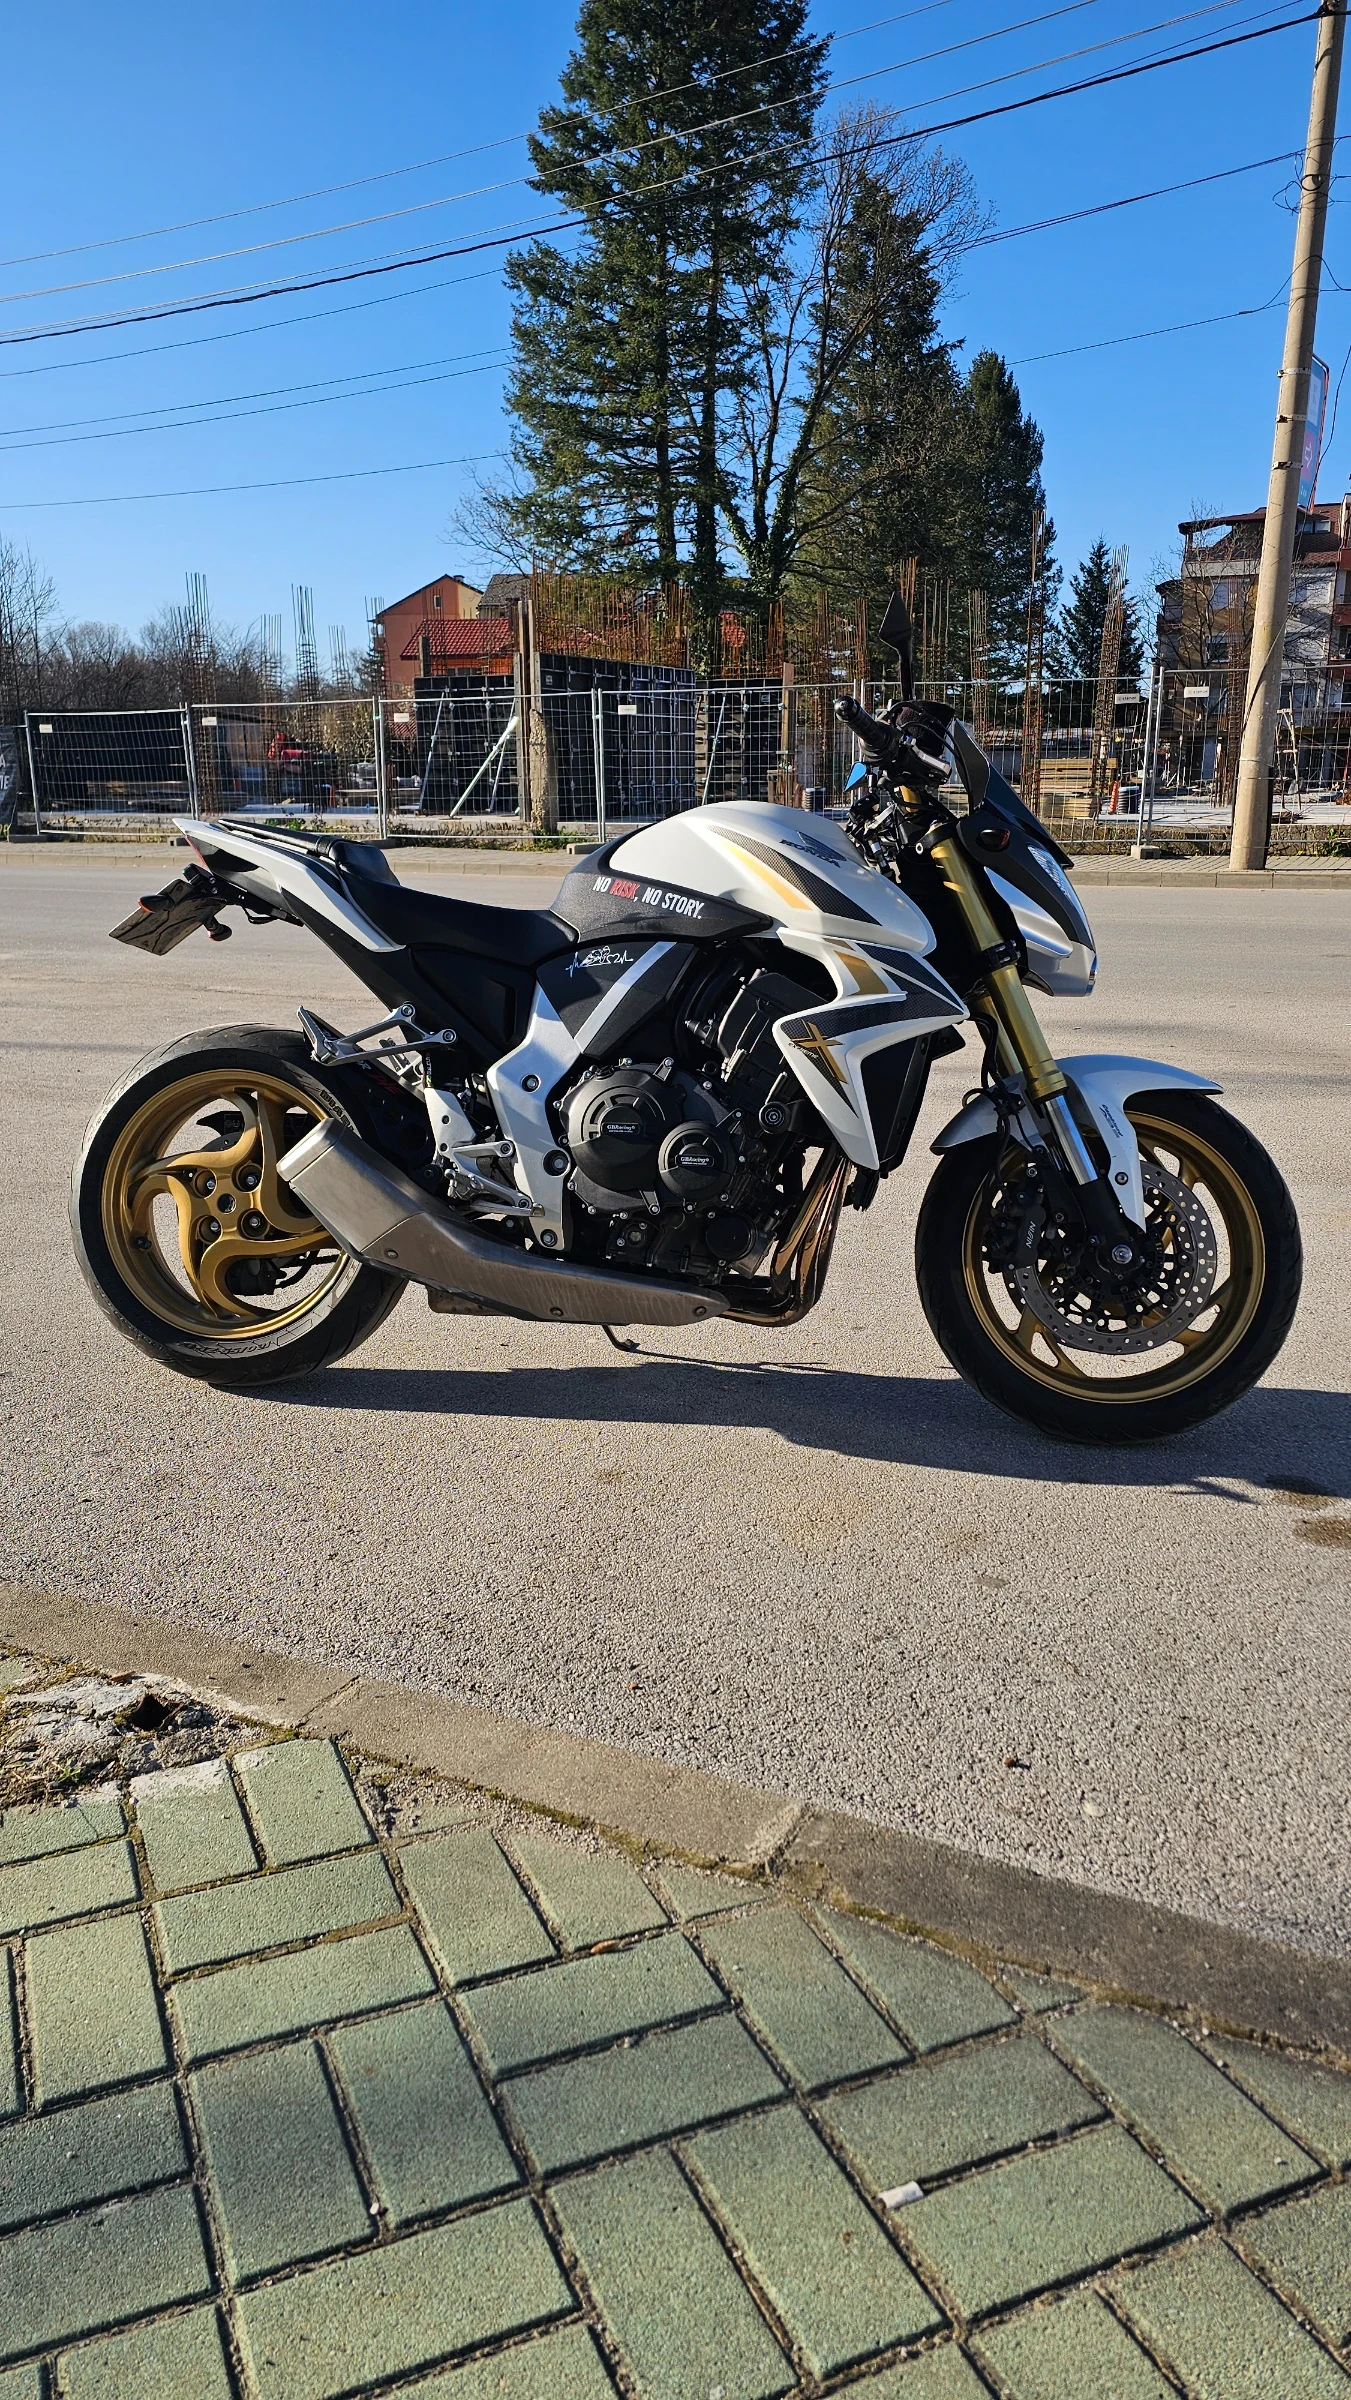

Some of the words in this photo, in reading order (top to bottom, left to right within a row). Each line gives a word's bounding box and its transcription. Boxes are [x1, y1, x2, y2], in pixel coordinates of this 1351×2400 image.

[779, 839, 841, 868] HONDA
[593, 877, 611, 893] NO
[609, 879, 641, 902] RISK,
[641, 887, 661, 906] NO
[662, 892, 705, 920] STORY.
